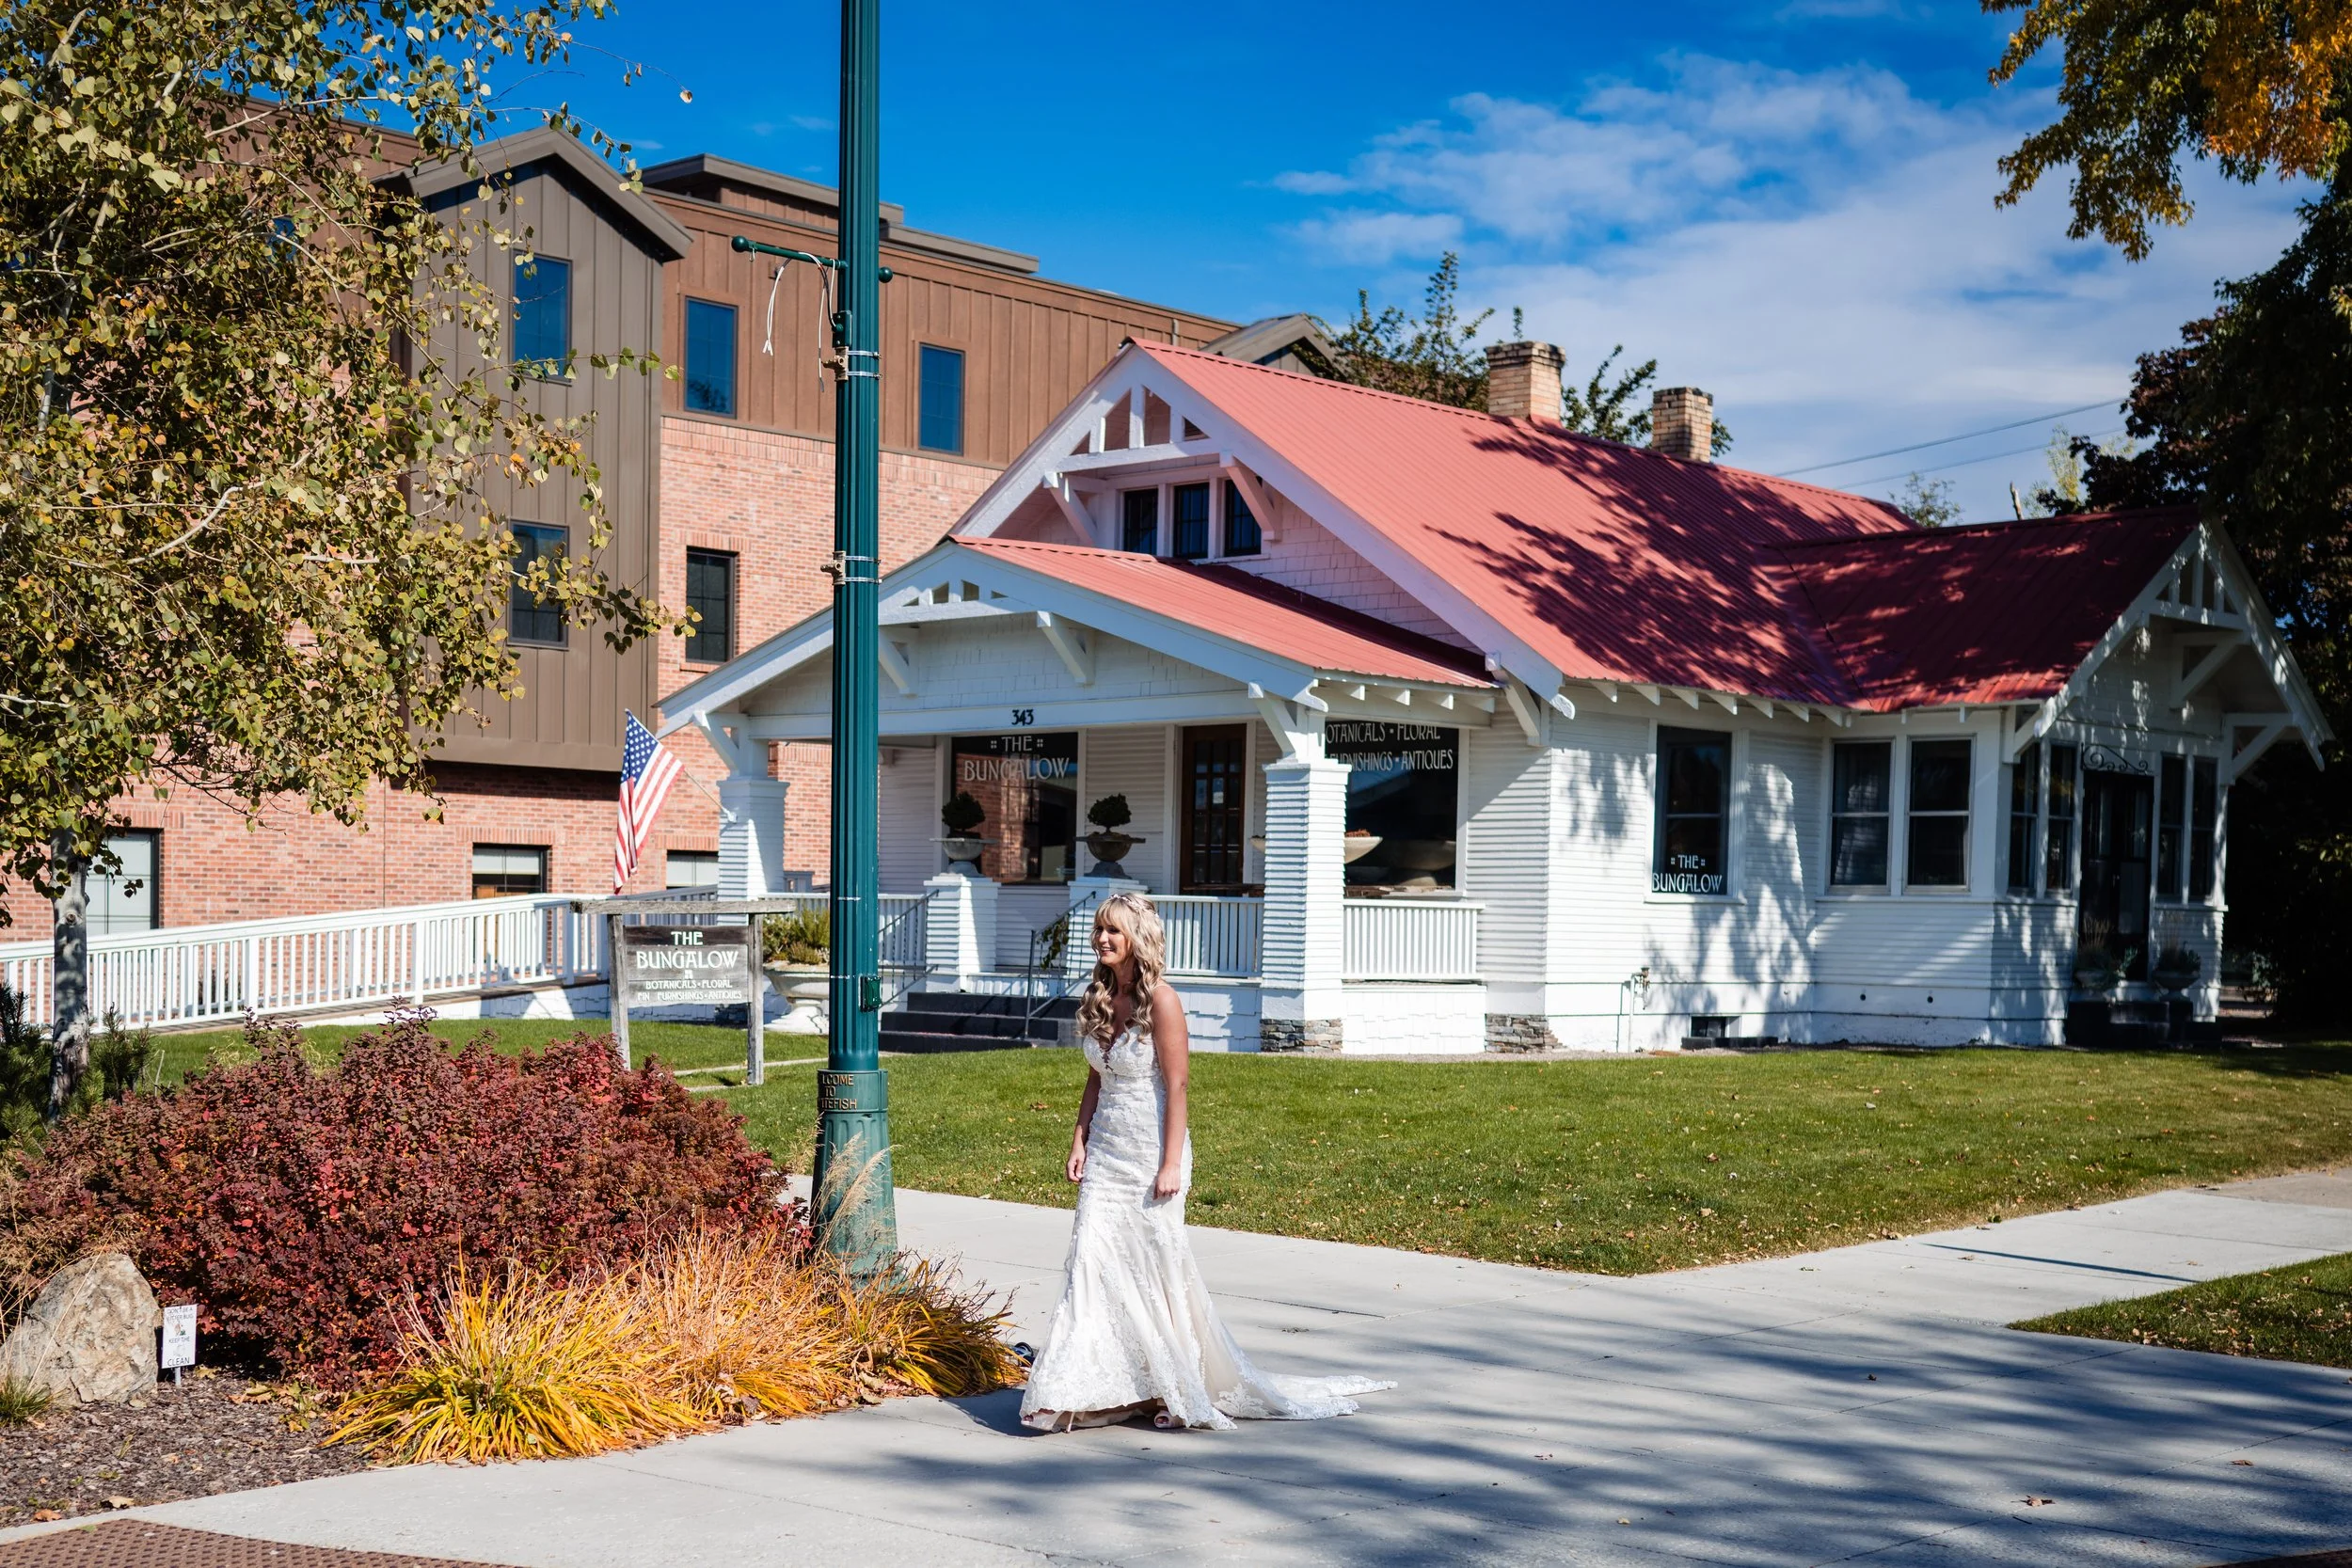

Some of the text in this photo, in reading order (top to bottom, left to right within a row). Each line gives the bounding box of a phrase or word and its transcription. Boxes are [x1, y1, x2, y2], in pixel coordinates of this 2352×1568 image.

[1011, 709, 1034, 726] 343
[1326, 722, 1441, 744] OTANICALS FLORAL
[1001, 736, 1033, 752] THE
[1401, 749, 1454, 770] ANTIQUES
[964, 757, 1070, 782] BUNGALOW
[1677, 854, 1699, 869] THE
[1652, 872, 1723, 893] BUNGALOW
[671, 931, 704, 945] THE
[636, 950, 739, 969] BUNGALOW
[645, 979, 733, 990] BOTANICALS FLORAL
[657, 990, 704, 1001] FURNISHINGS
[707, 990, 742, 1000] ANTIQUES
[822, 1074, 854, 1085] LCOME
[824, 1085, 836, 1097] TO
[167, 1356, 190, 1367] CLEAN
